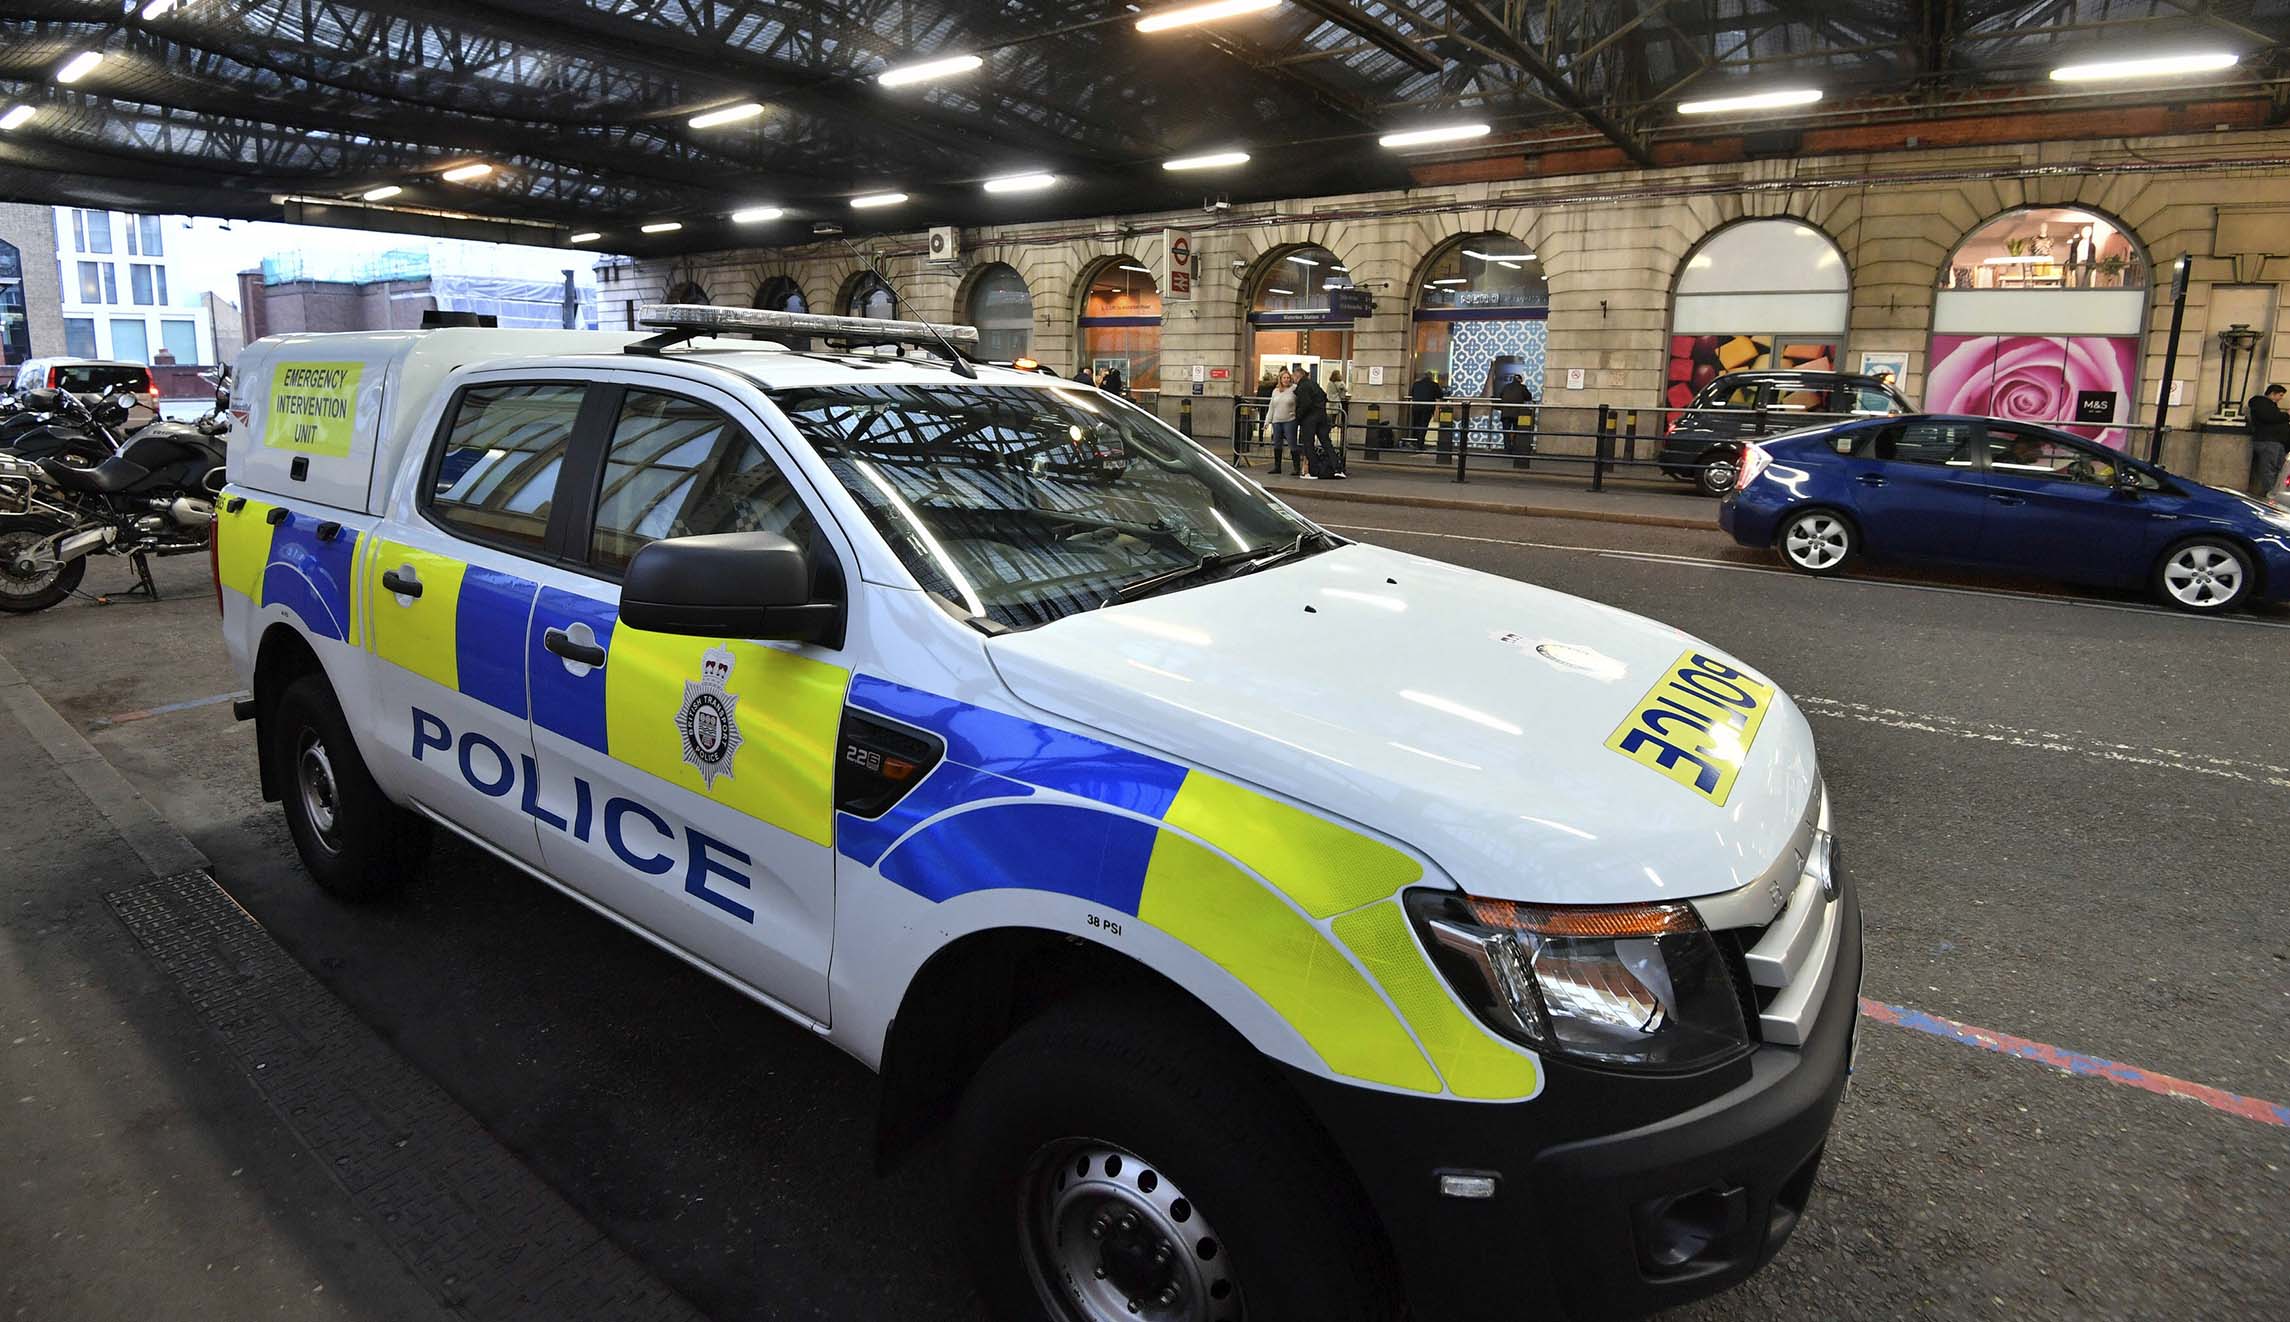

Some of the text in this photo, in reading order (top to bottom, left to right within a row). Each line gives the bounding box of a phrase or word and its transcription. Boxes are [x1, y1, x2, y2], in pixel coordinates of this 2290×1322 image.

[284, 368, 348, 389] EMERGENCY
[277, 395, 347, 419] INTERVENTION
[2083, 400, 2108, 409] M&S
[295, 424, 318, 444] UNIT
[688, 695, 728, 748] BRITISH TRANSPORT
[695, 745, 719, 762] POLICE
[411, 706, 754, 924] POLICE
[1087, 913, 1122, 936] 38 PSI
